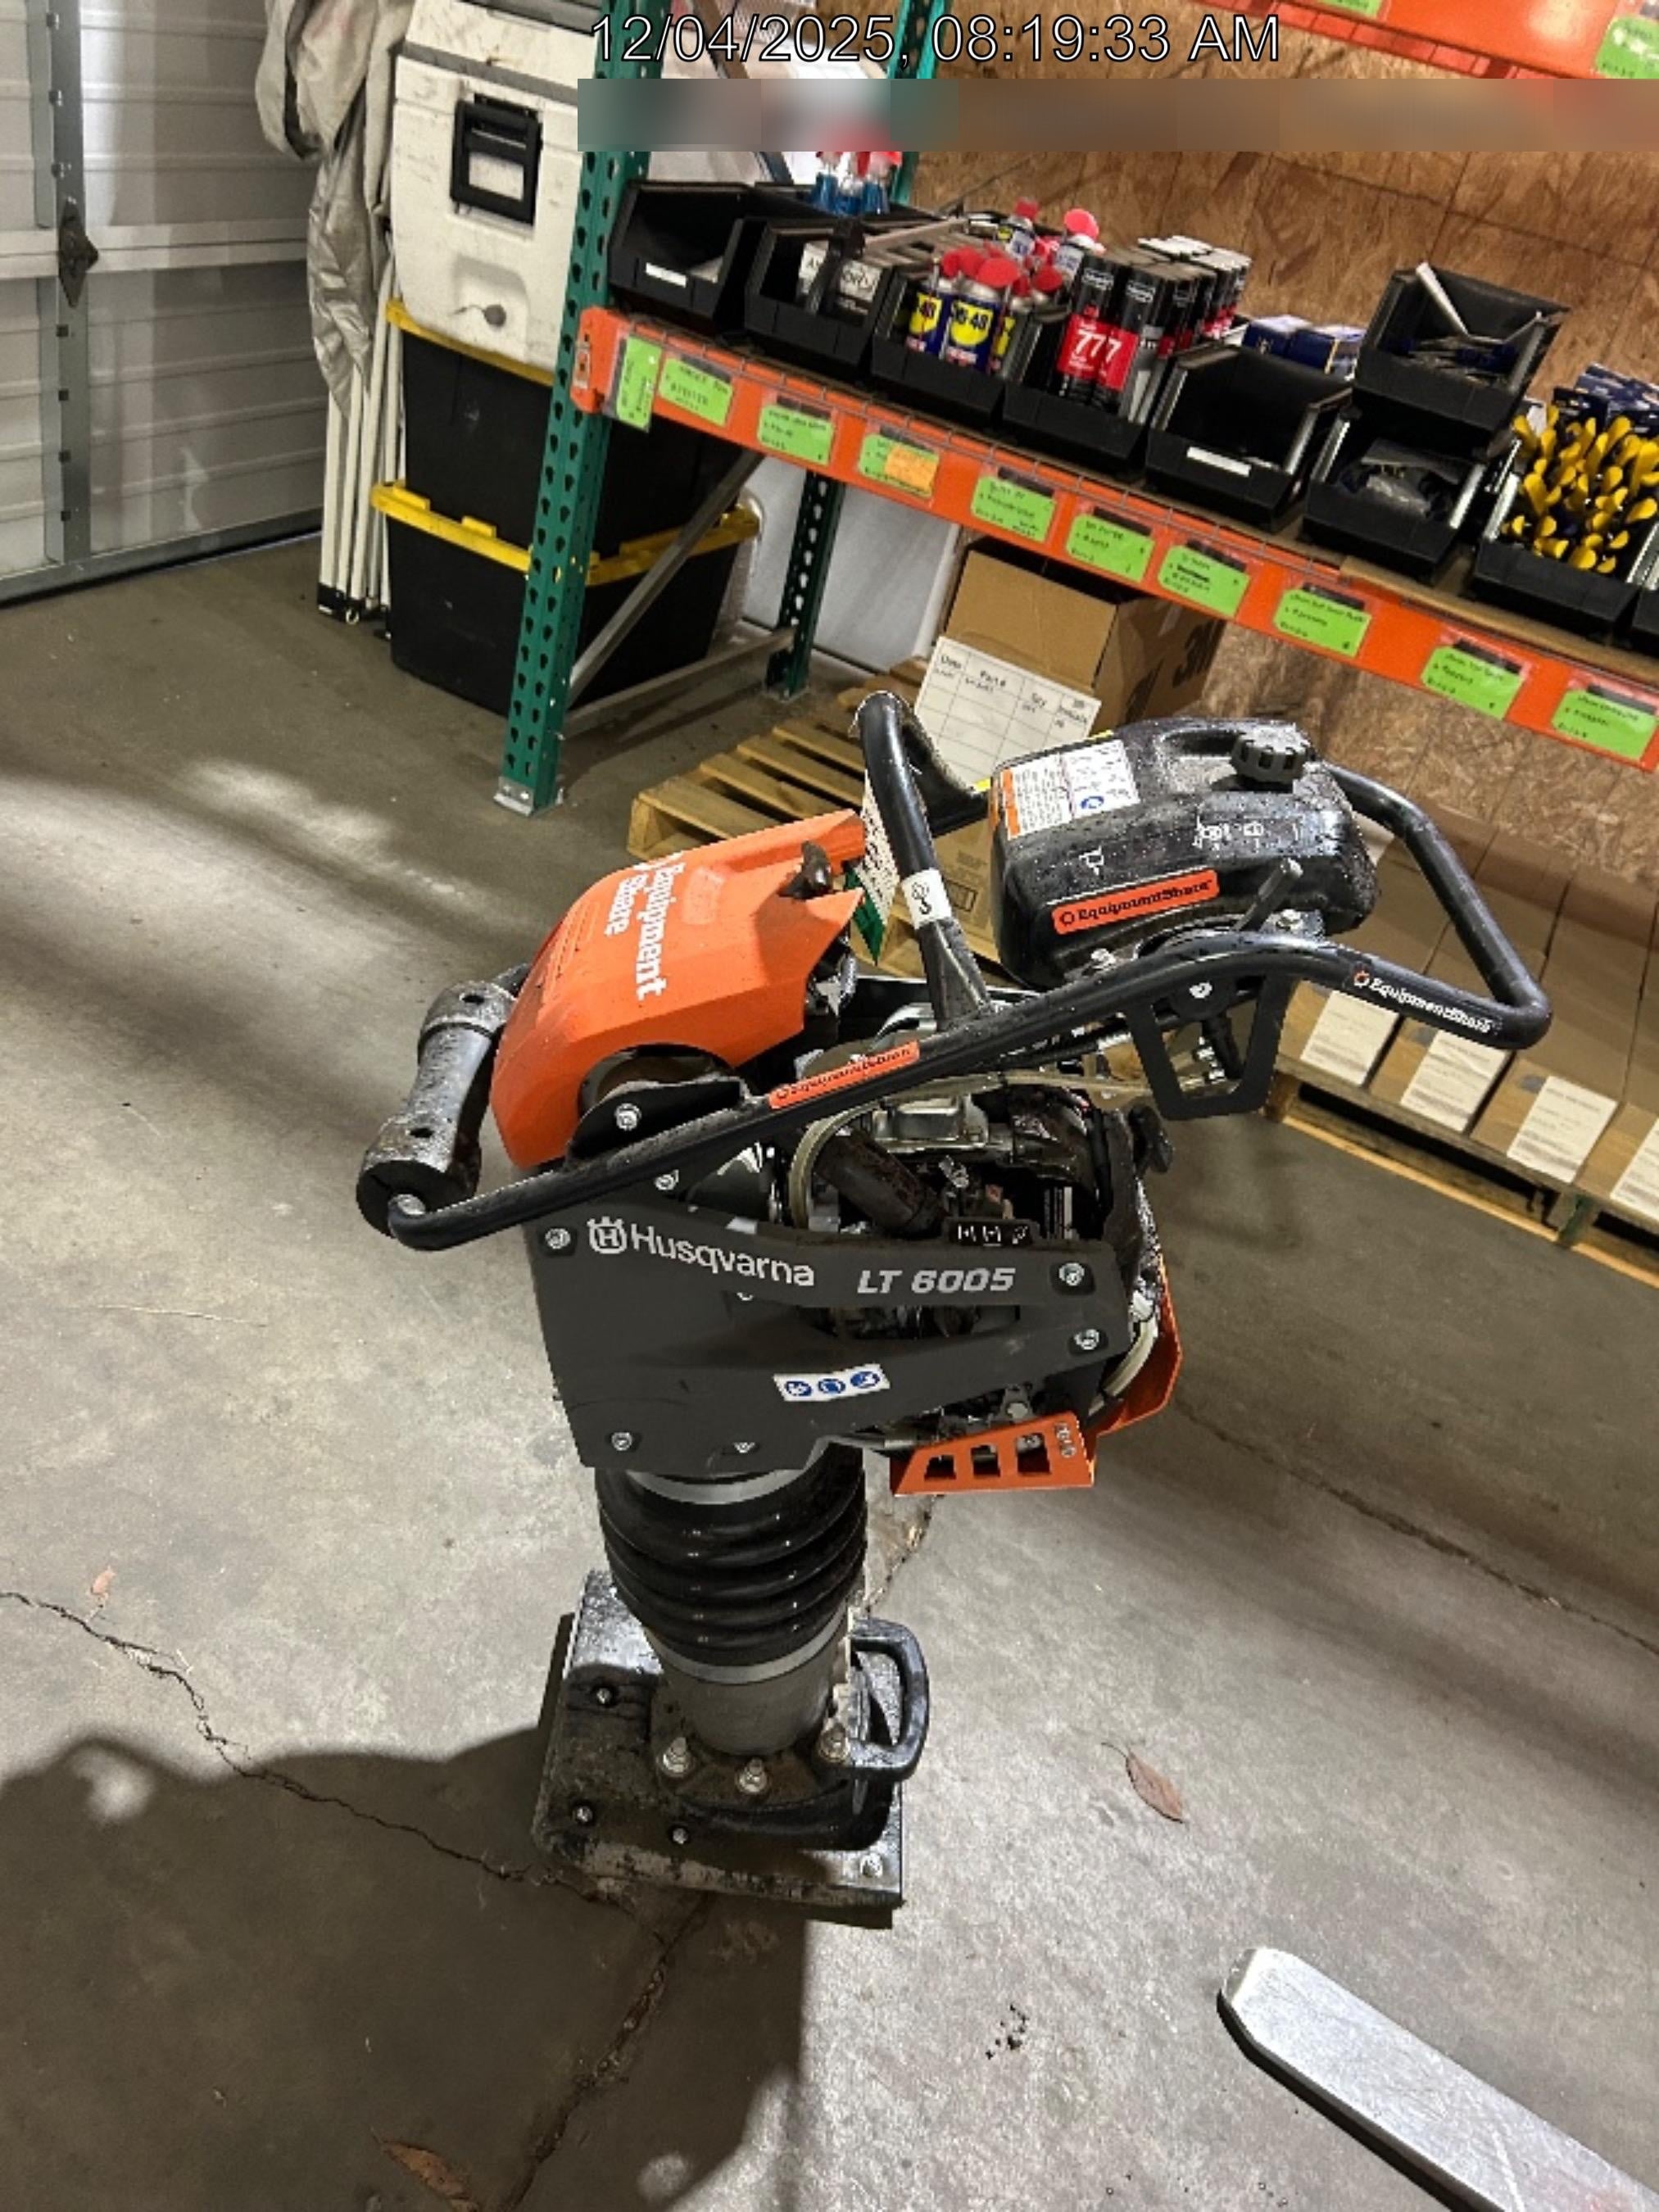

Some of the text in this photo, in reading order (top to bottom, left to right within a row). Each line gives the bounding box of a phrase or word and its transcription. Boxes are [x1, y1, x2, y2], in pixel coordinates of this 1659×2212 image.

[1077, 882, 1209, 920] EquipmentShare
[631, 1223, 814, 1287] Husqvarna
[857, 1267, 1017, 1294] LT 6005
